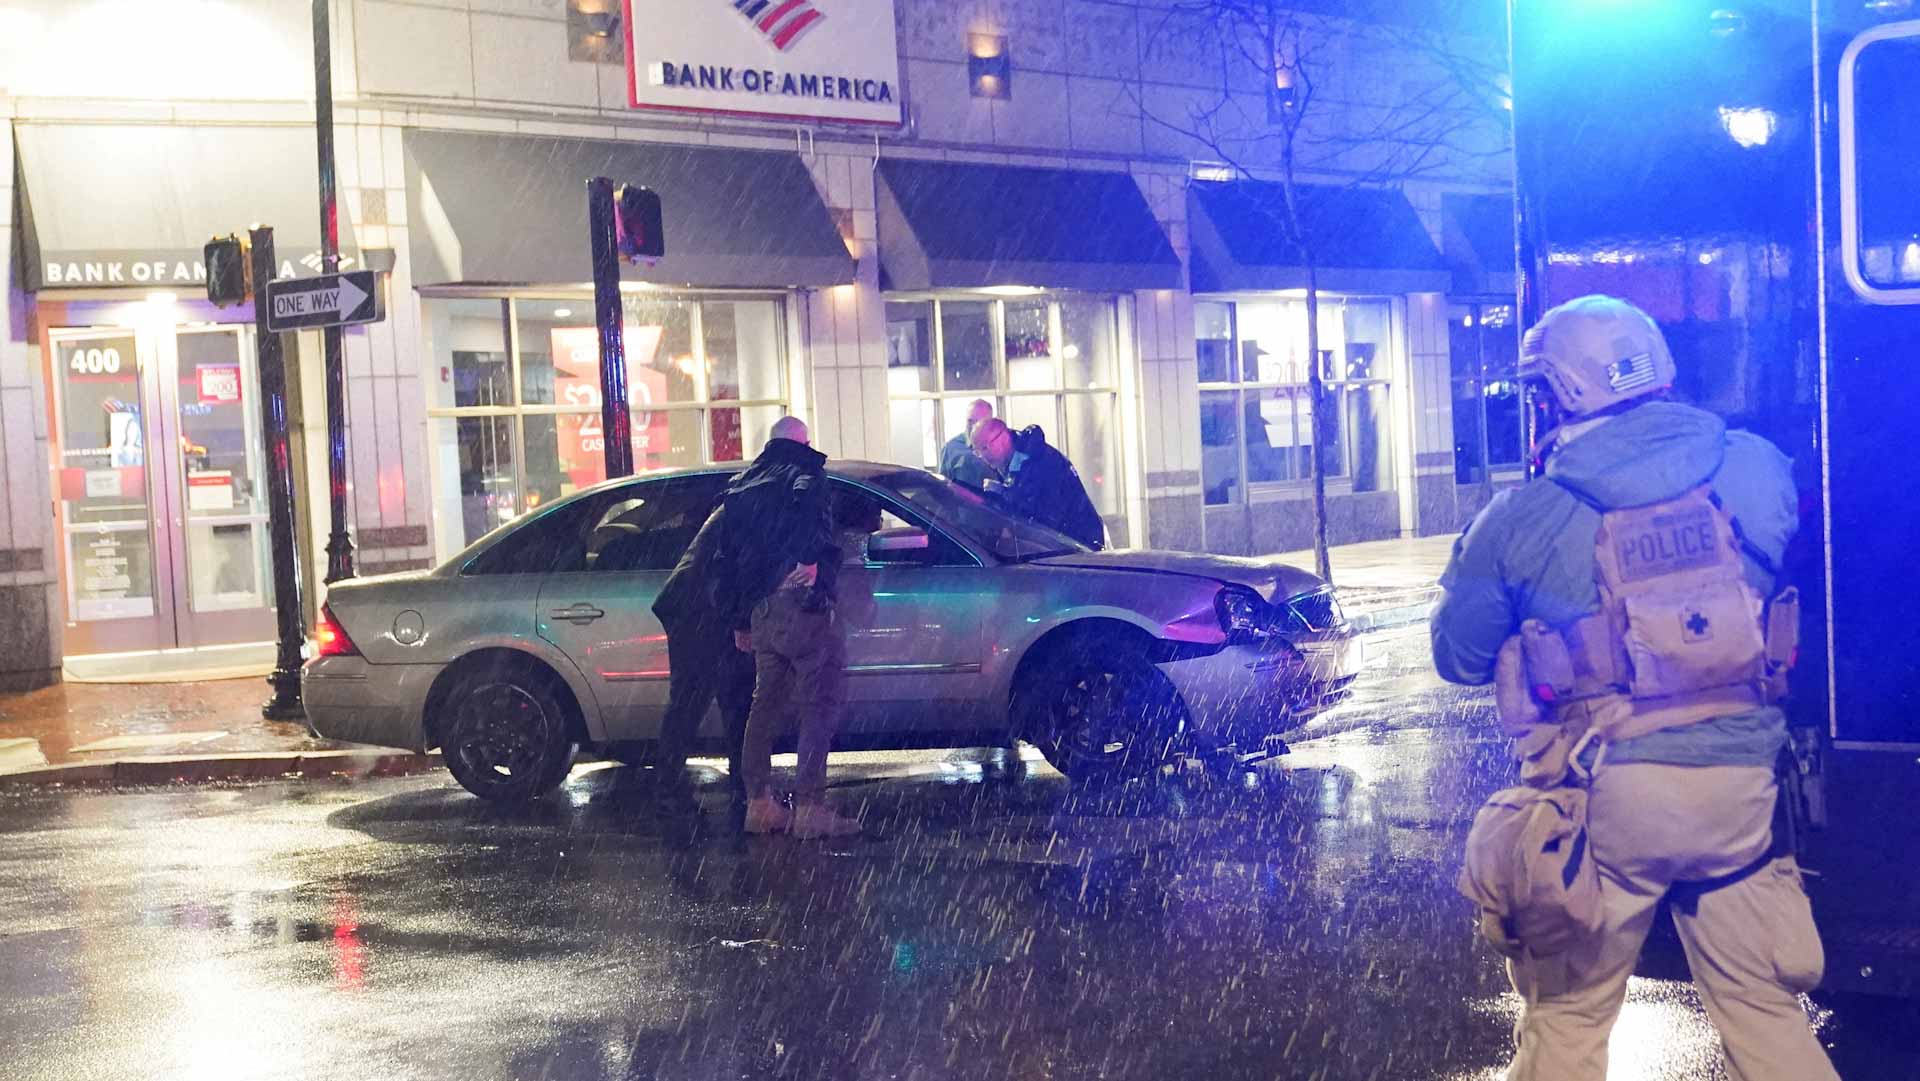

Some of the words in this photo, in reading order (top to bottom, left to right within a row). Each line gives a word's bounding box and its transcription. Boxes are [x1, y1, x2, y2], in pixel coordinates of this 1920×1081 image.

[661, 62, 733, 90] BANK
[743, 69, 773, 92] OF
[782, 73, 892, 102] AMERICA
[47, 262, 124, 282] BANK
[131, 260, 166, 281] OF
[276, 296, 304, 314] ONE
[311, 291, 340, 311] WAY
[70, 348, 120, 374] 400
[565, 381, 652, 436] $20
[582, 438, 605, 452] CAS
[1623, 522, 1715, 567] POLICE
